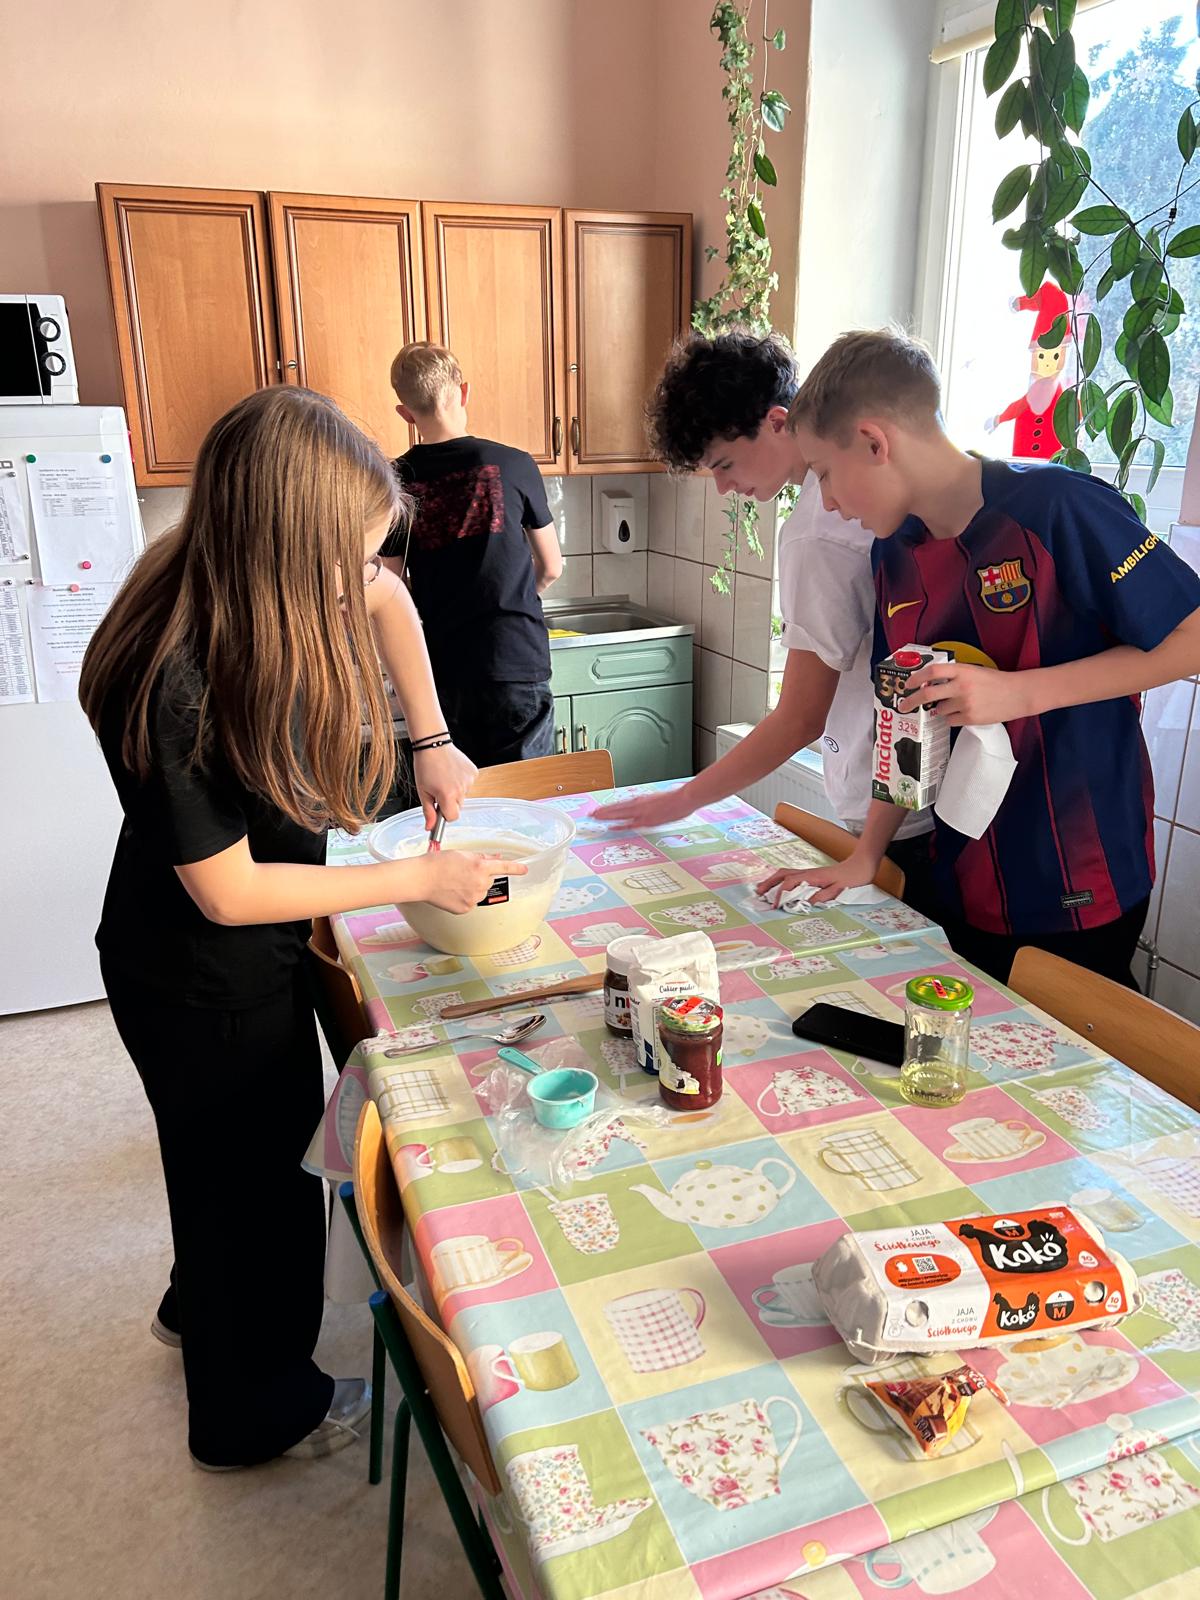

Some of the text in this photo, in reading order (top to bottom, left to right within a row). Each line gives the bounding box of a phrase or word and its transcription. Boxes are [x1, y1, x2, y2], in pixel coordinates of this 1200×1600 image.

[911, 1228, 932, 1237] JAJA
[956, 1307, 975, 1316] JAJA
[1053, 1307, 1066, 1318] M
